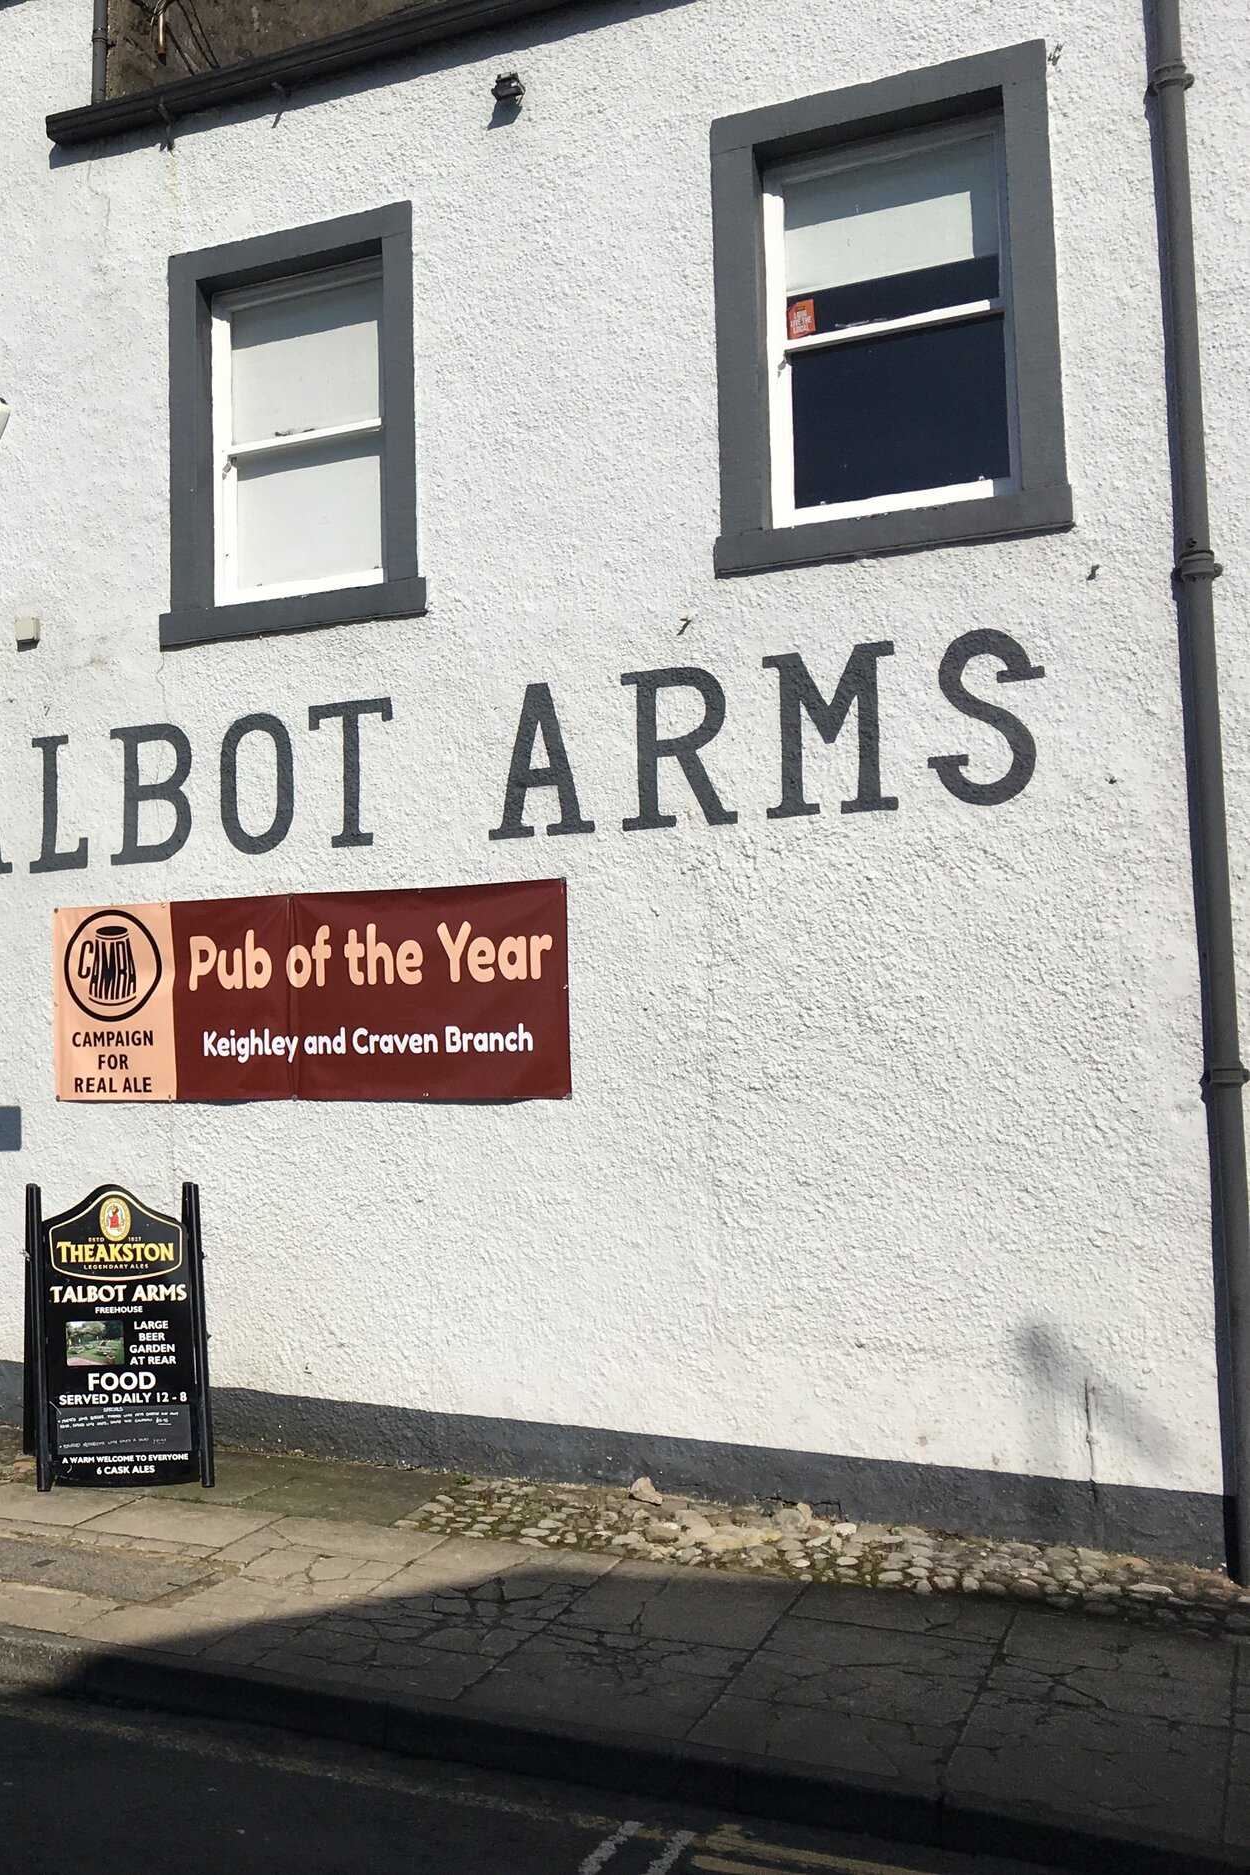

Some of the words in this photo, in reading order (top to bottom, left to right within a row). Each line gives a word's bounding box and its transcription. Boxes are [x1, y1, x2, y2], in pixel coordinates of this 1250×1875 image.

[488, 628, 1046, 841] ARMS
[188, 929, 272, 992] Pub
[286, 924, 332, 988] of
[344, 923, 424, 986] the
[436, 920, 553, 983] Year
[78, 936, 137, 1000] CAMRA
[72, 1030, 154, 1048] CAMPAIGN
[203, 1028, 298, 1063] Keighley
[304, 1027, 346, 1056] and
[352, 1027, 438, 1055] Craven
[445, 1023, 534, 1054] Branch
[98, 1054, 129, 1070] FOR
[74, 1077, 118, 1093] REAL
[122, 1077, 152, 1093] ALE
[56, 1242, 174, 1263] THEAKSTON
[50, 1285, 127, 1304] TALBOT
[132, 1284, 188, 1302] ARMS
[94, 1306, 143, 1314] FREEHOUSE
[134, 1320, 168, 1330] LARGE
[138, 1332, 165, 1342] BEER
[130, 1344, 175, 1354] GARDEN
[130, 1356, 146, 1366] AT
[148, 1356, 176, 1364] REAR
[88, 1372, 156, 1391] FOOD
[59, 1394, 108, 1406] SERVED
[111, 1393, 151, 1405] DAILY
[156, 1393, 168, 1402] 12
[180, 1392, 188, 1402] 8
[148, 1453, 188, 1461] EVERYONE
